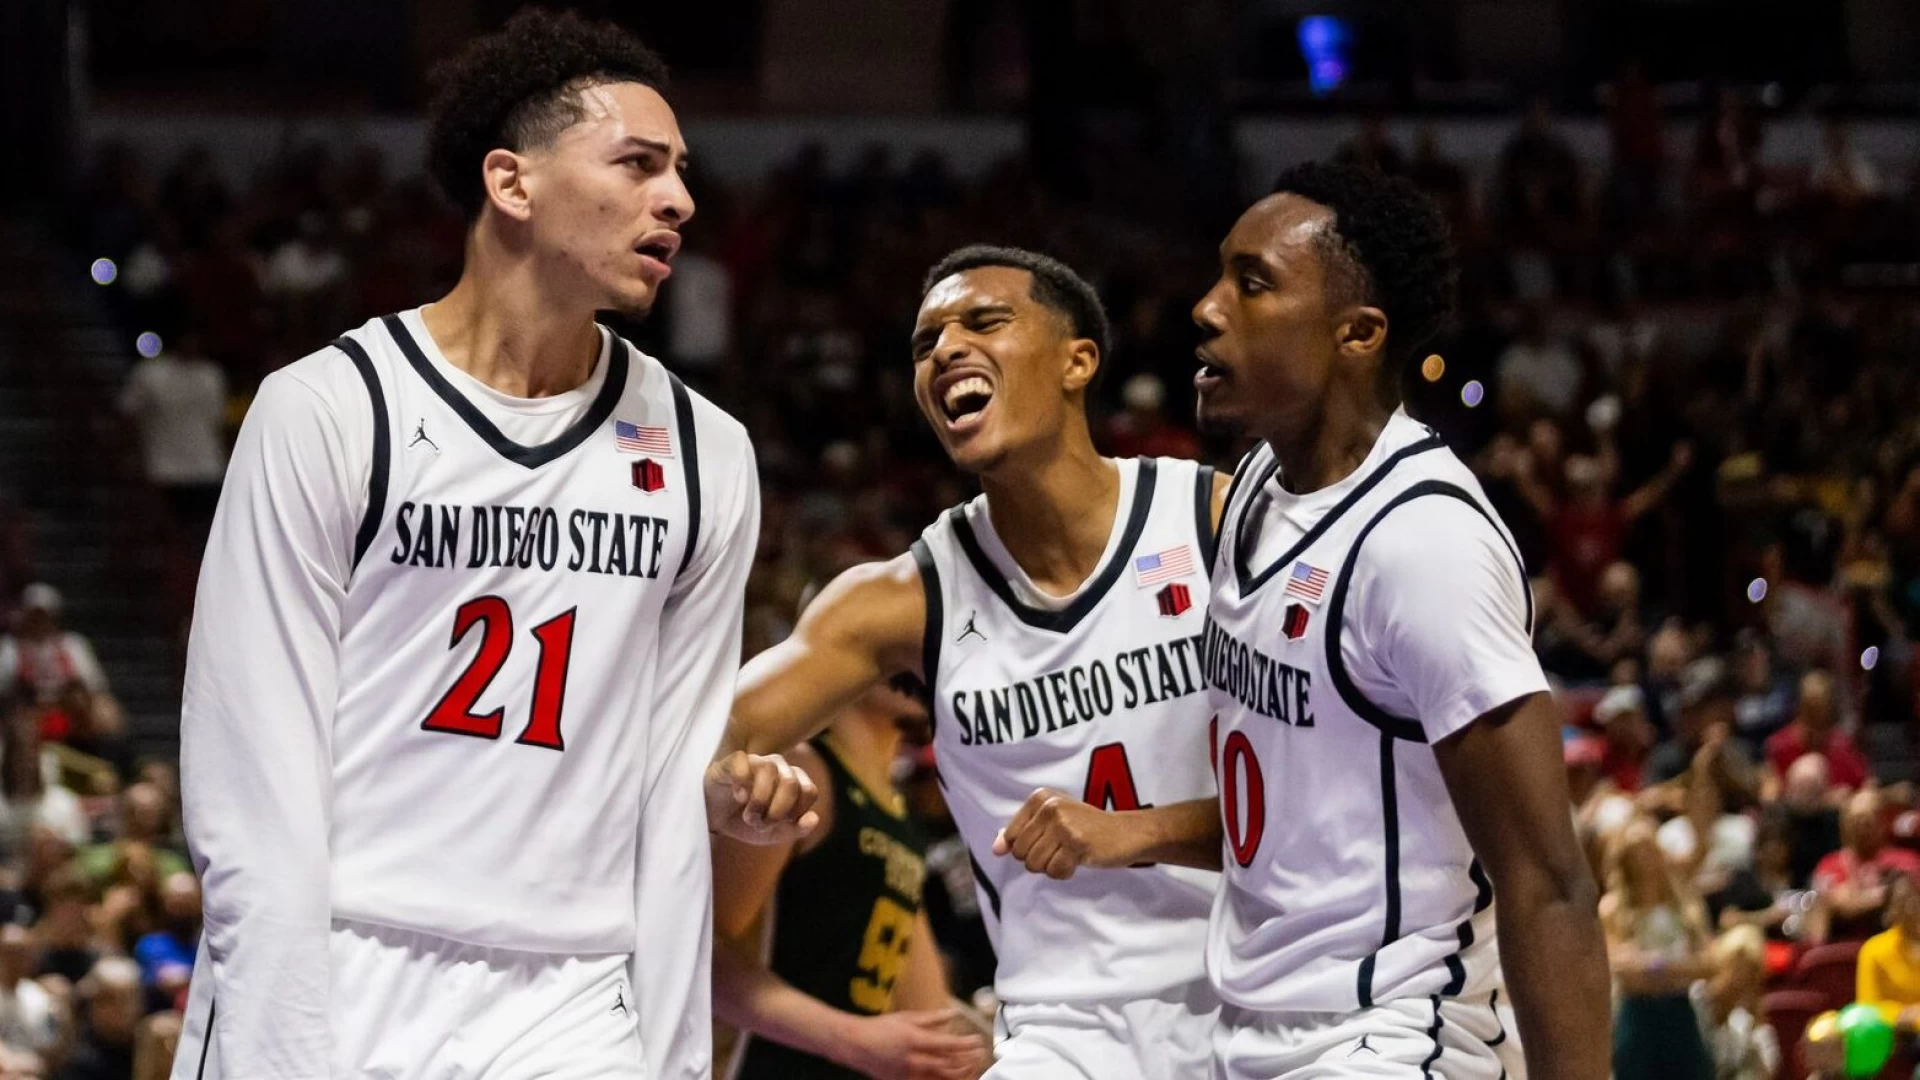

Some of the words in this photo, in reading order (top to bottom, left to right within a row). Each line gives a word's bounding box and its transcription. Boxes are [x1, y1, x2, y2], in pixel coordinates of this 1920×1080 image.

[390, 501, 461, 569] SAN
[466, 505, 559, 572] DIEGO
[567, 508, 669, 579] STATE
[420, 595, 578, 752] 21
[952, 686, 1014, 746] SAN
[1008, 658, 1113, 739] DIEGO
[1249, 648, 1316, 728] STATE
